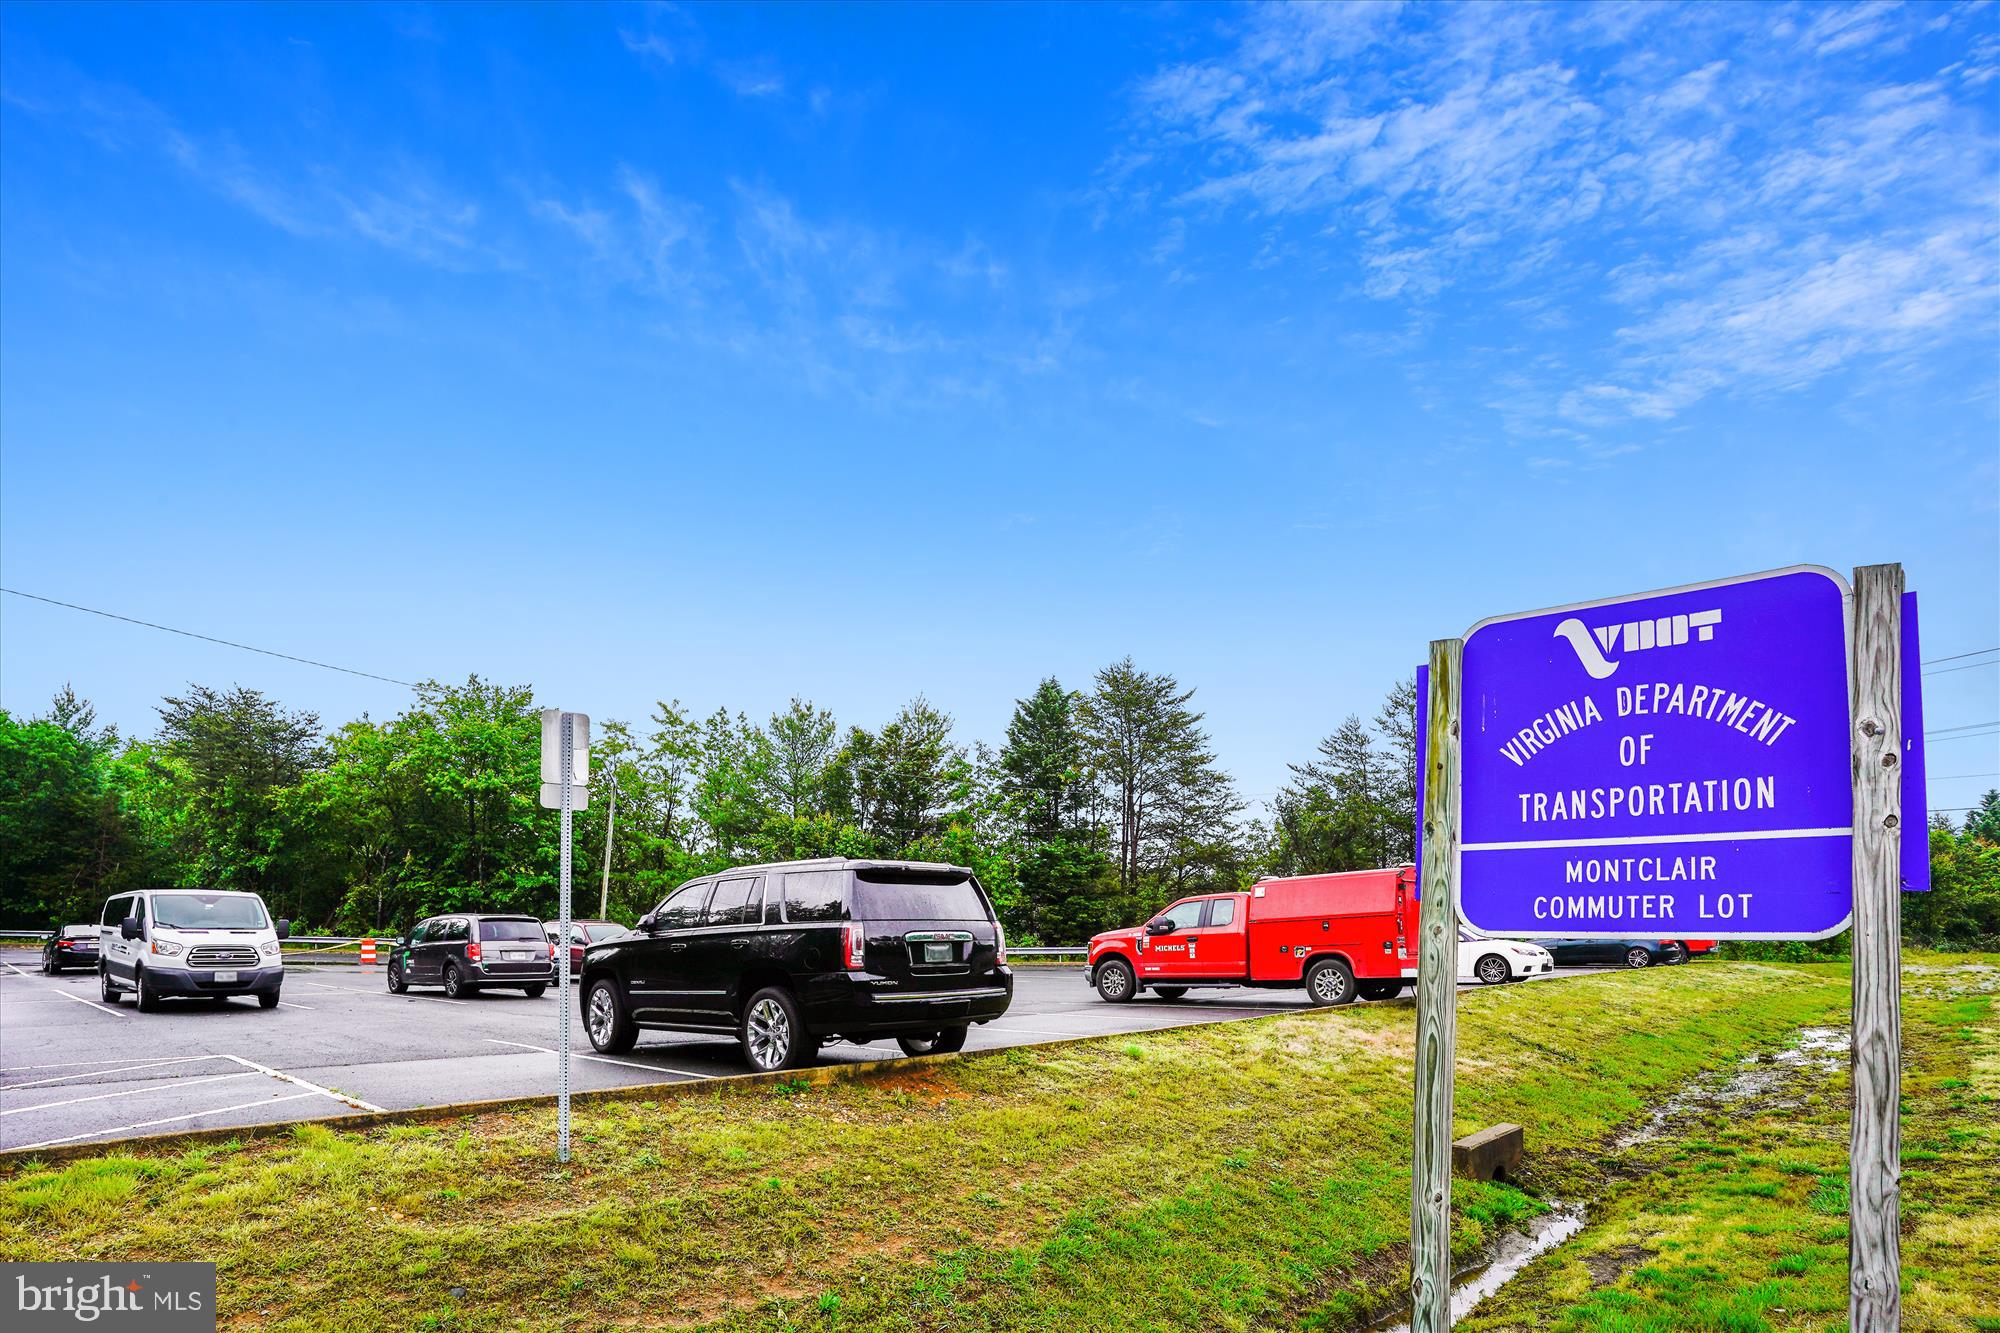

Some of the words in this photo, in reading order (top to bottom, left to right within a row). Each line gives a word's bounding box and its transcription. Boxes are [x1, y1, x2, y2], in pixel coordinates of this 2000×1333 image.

[1553, 609, 1722, 680] VDOT
[1500, 696, 1603, 767] VIRGINIA
[1616, 683, 1796, 747] DEPARTMENT
[1619, 734, 1654, 767] OF
[1518, 776, 1775, 823] TRANSPORTATION
[1566, 856, 1717, 883] MONTCLAIR
[1533, 894, 1675, 919] COMMUTER
[1699, 893, 1753, 919] LOT
[1154, 944, 1186, 952] MICHELS
